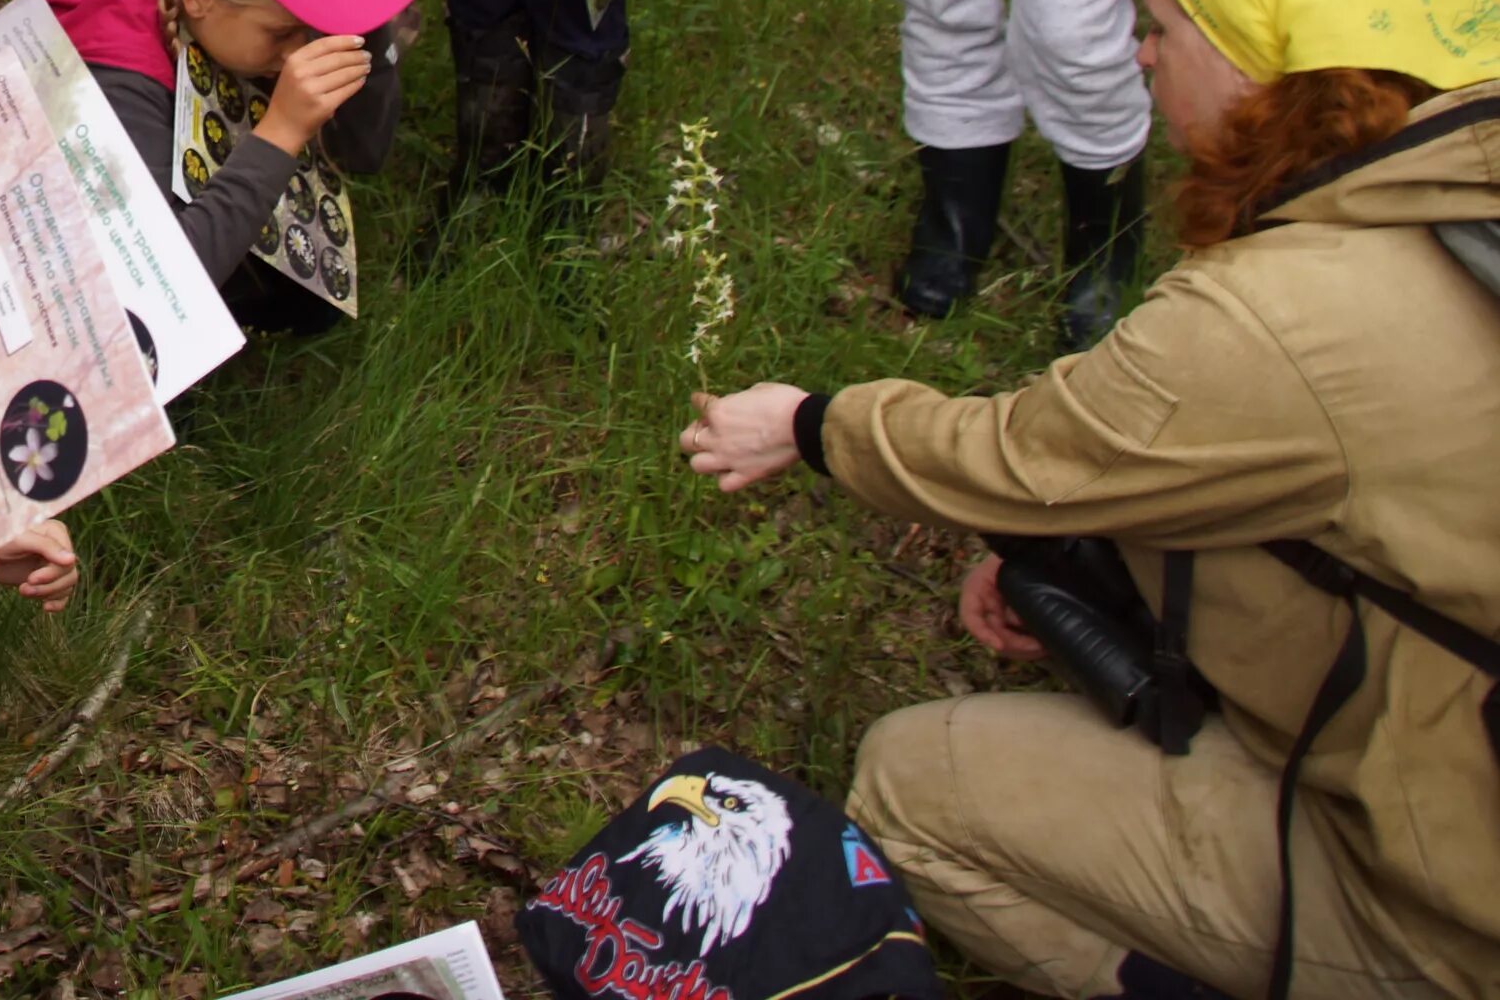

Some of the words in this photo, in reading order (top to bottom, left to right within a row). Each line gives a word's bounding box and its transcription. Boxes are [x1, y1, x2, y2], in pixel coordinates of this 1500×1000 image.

[10, 184, 47, 256] растений
[44, 260, 56, 280] по
[29, 173, 77, 287] Определитель
[75, 288, 115, 388] травянистых
[76, 124, 135, 229] Определитель
[133, 229, 188, 323] травянистых
[99, 207, 111, 226] по
